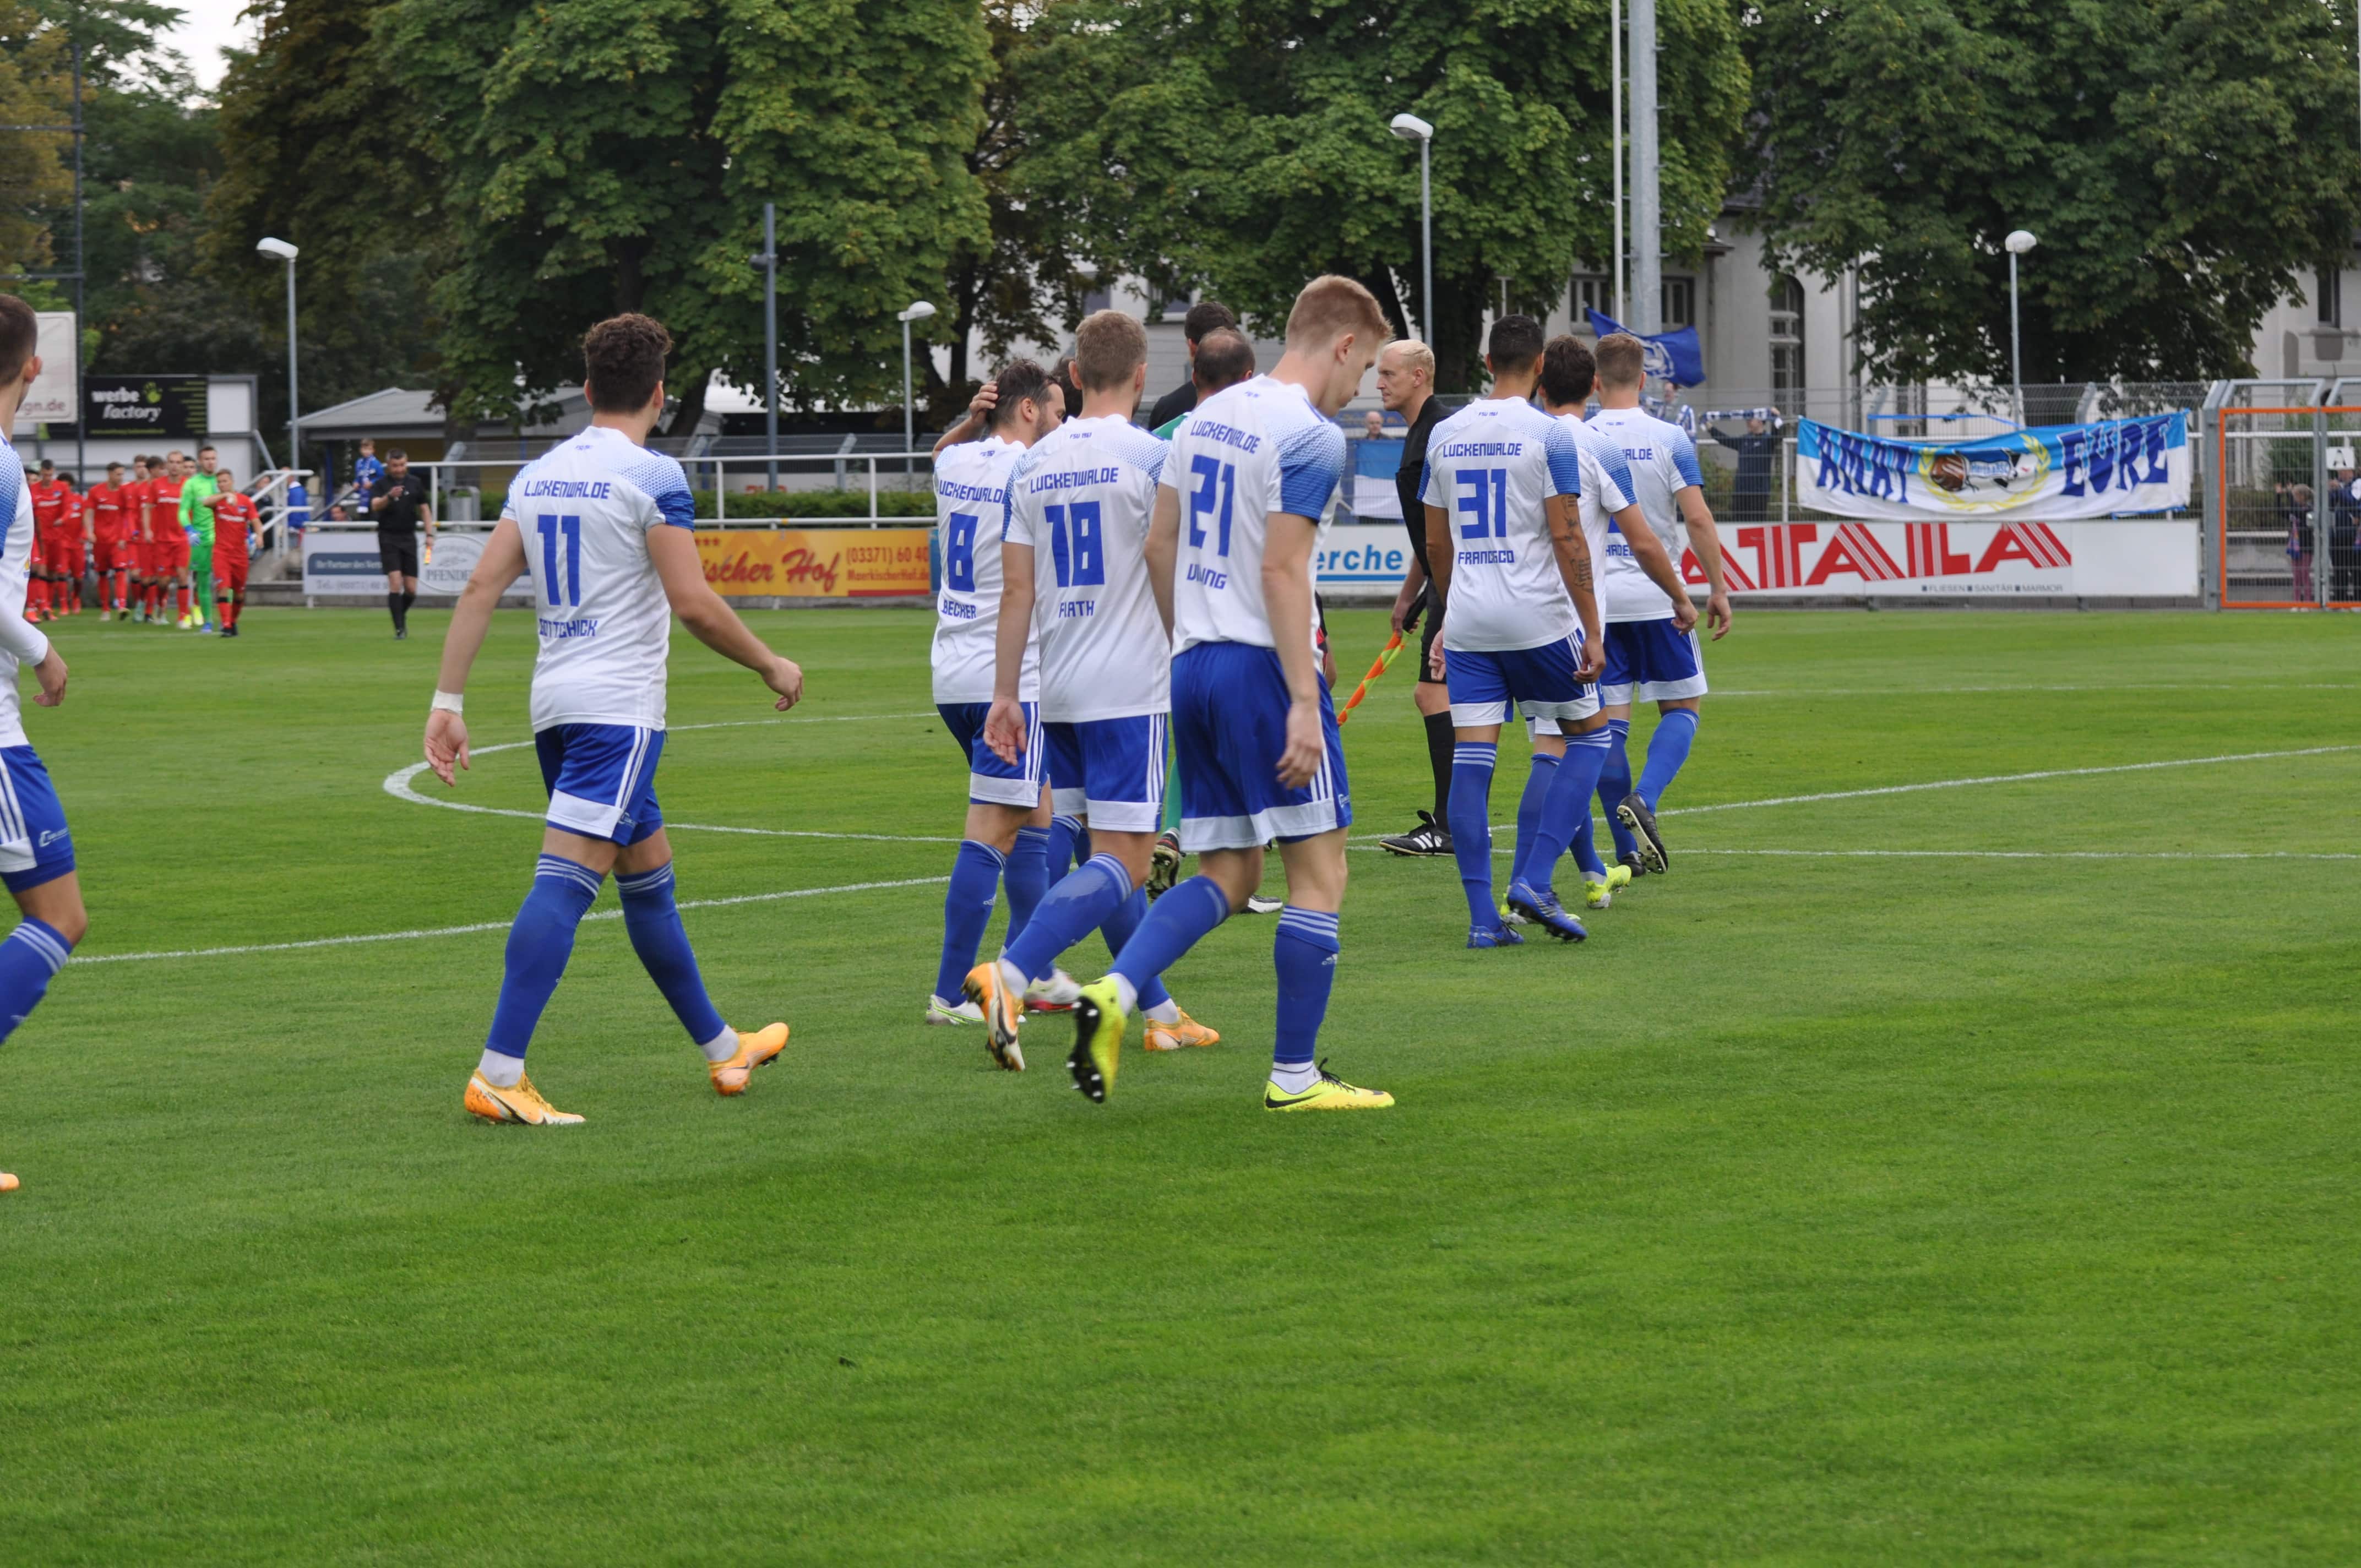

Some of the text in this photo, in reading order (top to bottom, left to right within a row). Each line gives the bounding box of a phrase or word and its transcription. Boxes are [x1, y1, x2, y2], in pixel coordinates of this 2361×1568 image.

[91, 386, 140, 402] werbe
[102, 404, 161, 422] factory
[1443, 442, 1522, 458] LUCKENWALDE
[2333, 449, 2347, 467] A
[1030, 467, 1119, 494] LUCKENWALDE
[1189, 454, 1235, 558] 21
[1456, 468, 1506, 540] 31
[847, 547, 893, 565] (03371)
[947, 513, 978, 592] 8
[1045, 500, 1105, 588] 18
[537, 514, 580, 607] 11
[782, 548, 840, 592] Hof
[941, 599, 977, 619] BECKER
